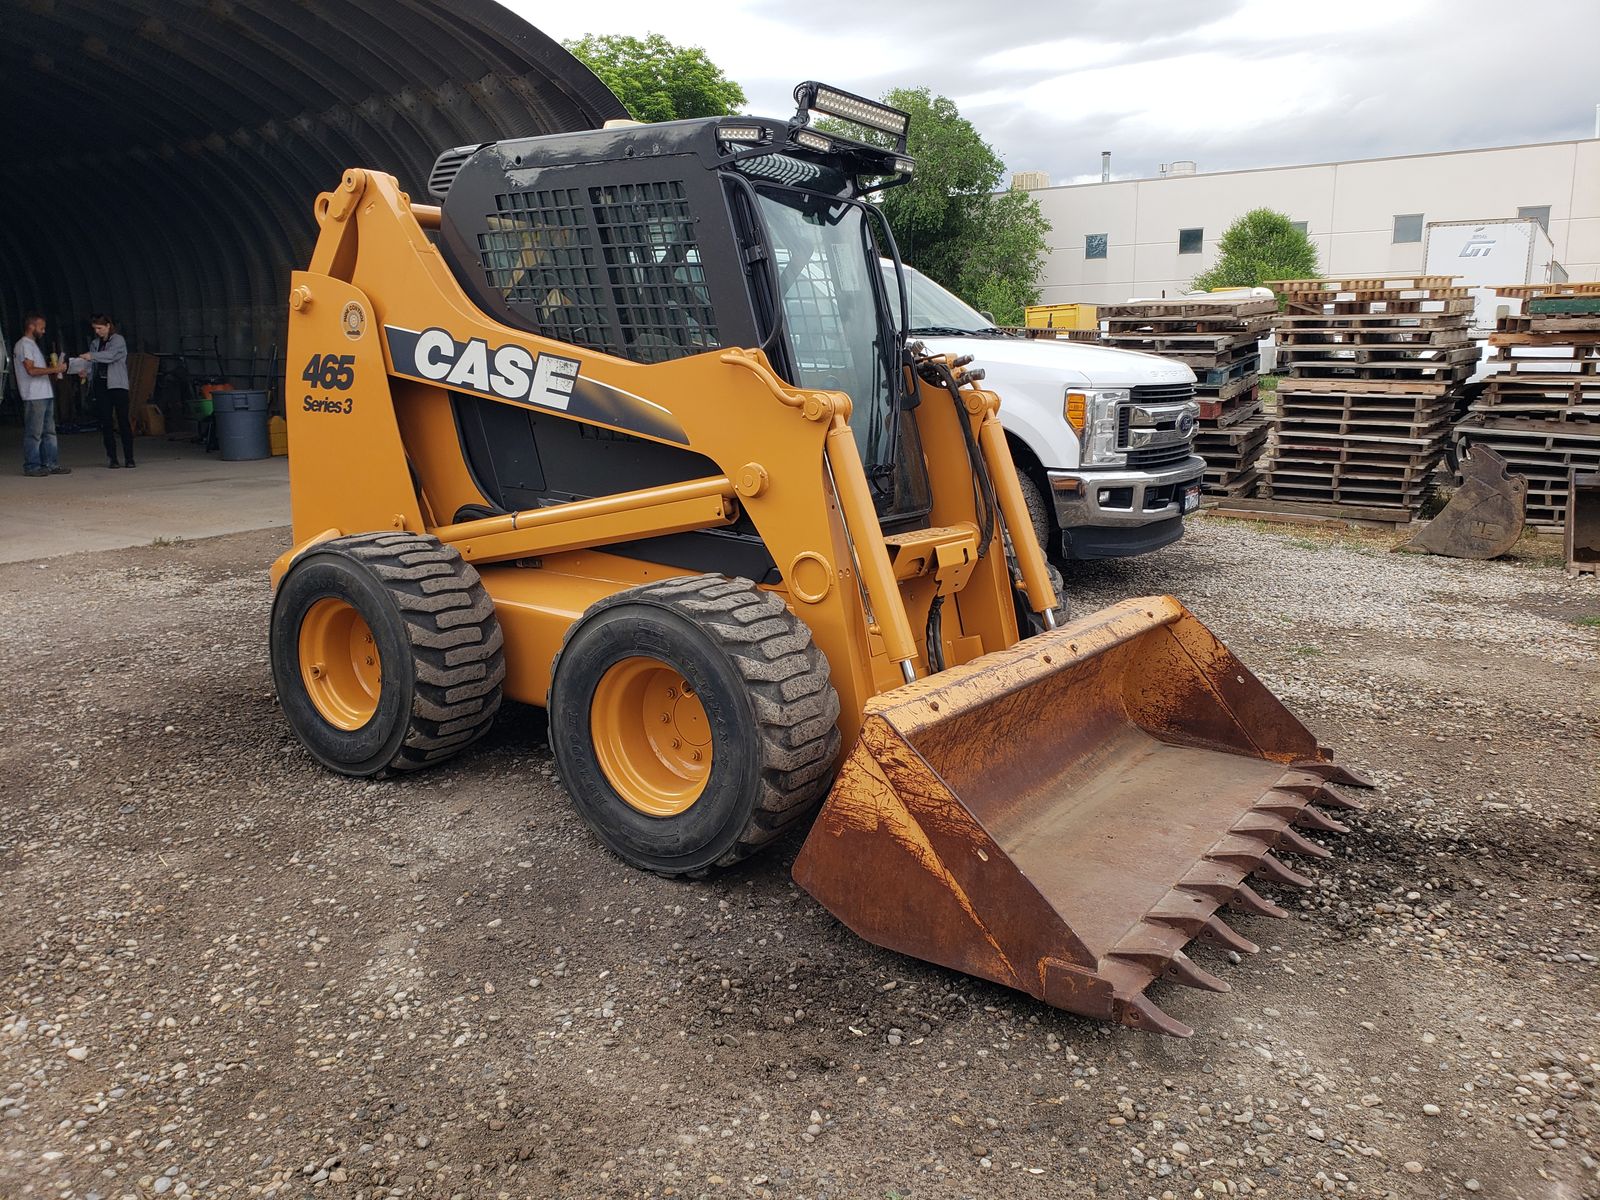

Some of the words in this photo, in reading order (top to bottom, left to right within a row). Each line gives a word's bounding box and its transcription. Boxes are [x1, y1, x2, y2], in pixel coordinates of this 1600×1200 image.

[302, 353, 356, 391] 465
[414, 329, 580, 411] CASE
[303, 394, 343, 413] Series
[343, 397, 353, 414] 3
